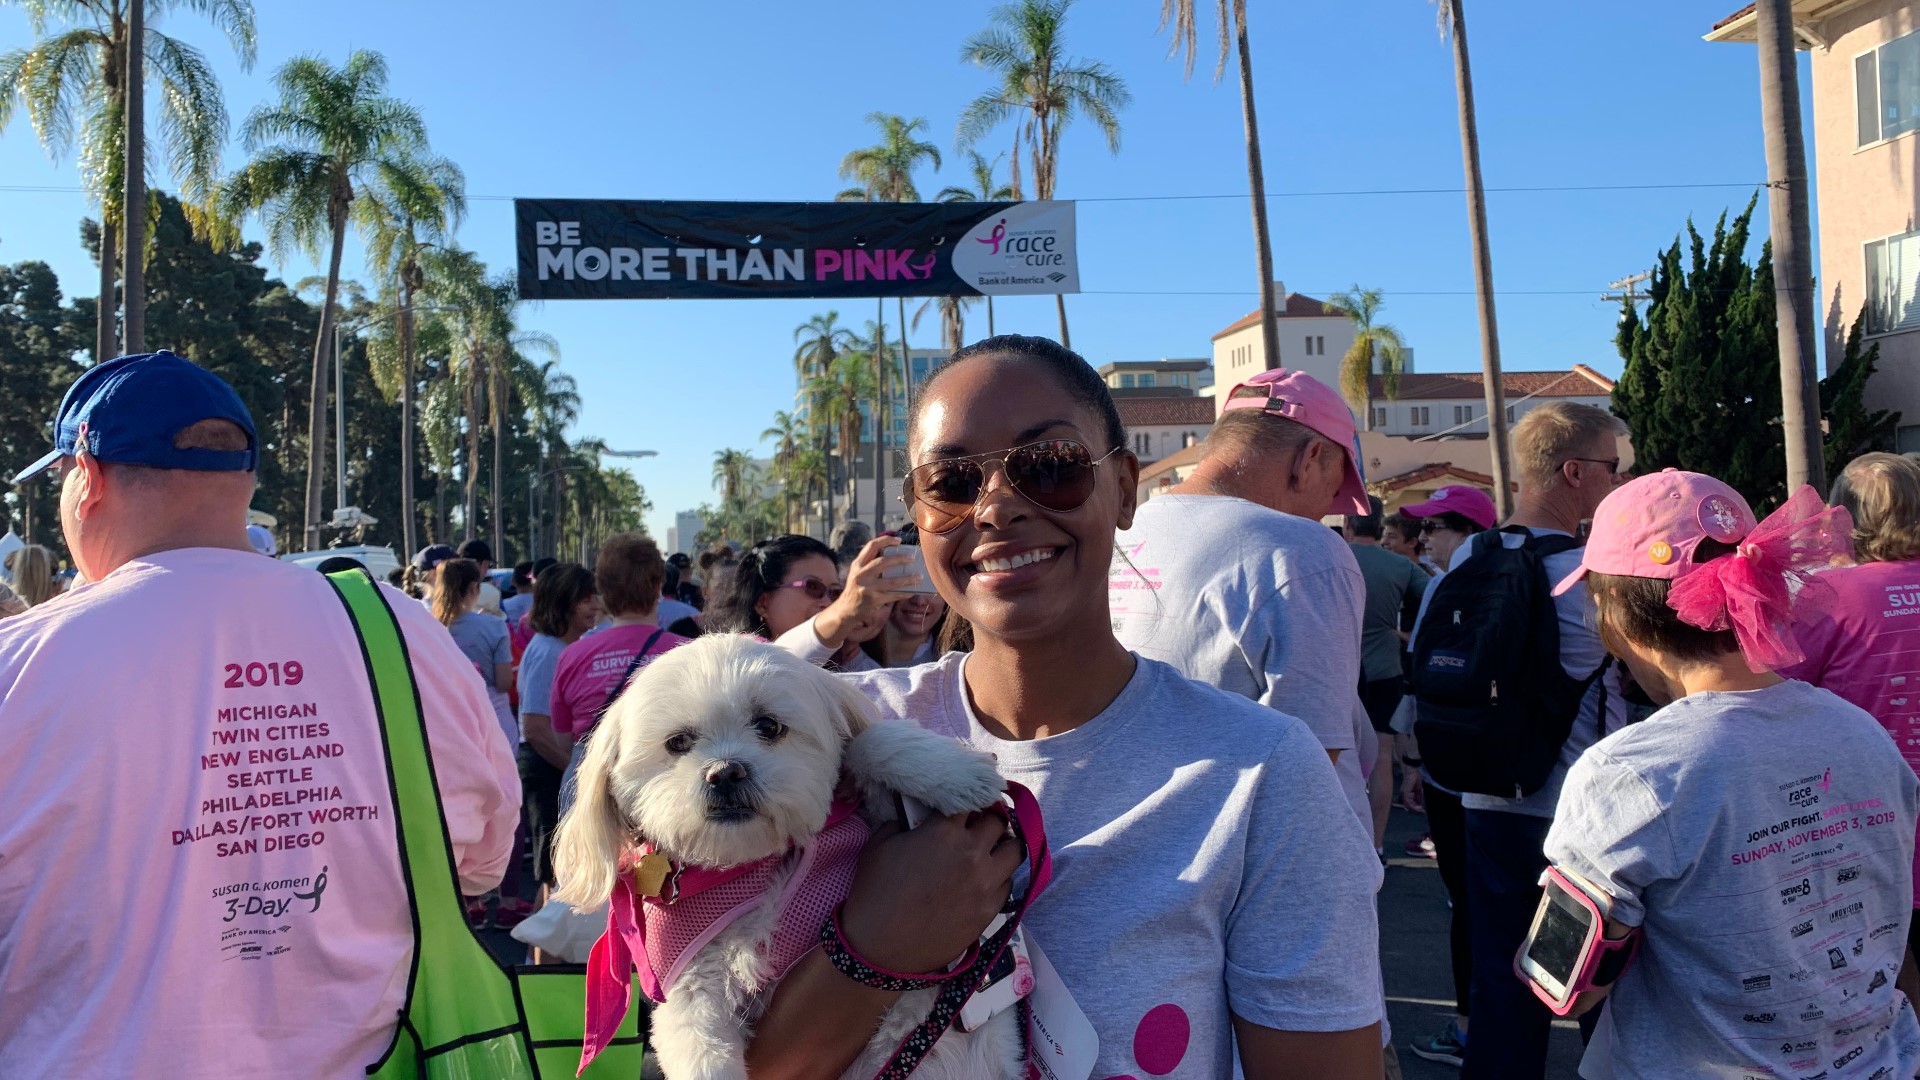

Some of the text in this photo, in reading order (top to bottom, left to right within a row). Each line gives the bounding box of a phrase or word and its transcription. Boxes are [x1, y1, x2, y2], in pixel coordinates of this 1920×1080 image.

[536, 221, 581, 246] BE
[1006, 236, 1056, 253] race
[537, 246, 918, 282] MORE THAN PINK
[979, 275, 1045, 285] Bank of America
[1108, 581, 1132, 590] EMBER
[224, 660, 304, 689] 2019
[217, 702, 317, 723] MICHIGAN
[212, 722, 330, 746] TWIN CITIES
[201, 743, 344, 770] NEW ENGLAND
[227, 767, 313, 789] SEATTLE
[202, 786, 343, 816] PHILADELPHIA
[1789, 786, 1812, 803] race
[172, 805, 378, 846] DALLAS/FORT WORTH
[1746, 827, 1769, 844] JOIN
[1771, 820, 1790, 835] OUR
[1791, 812, 1823, 828] FIGHT.
[216, 831, 325, 858] SAN DIEGO
[1731, 811, 1896, 866] SUNDAY, NOVEMBER 3, 2019
[252, 882, 261, 891] G.
[1781, 878, 1811, 898] NEWS 8
[1032, 1014, 1054, 1045] AMERICA
[1832, 1046, 1864, 1070] GEICO
